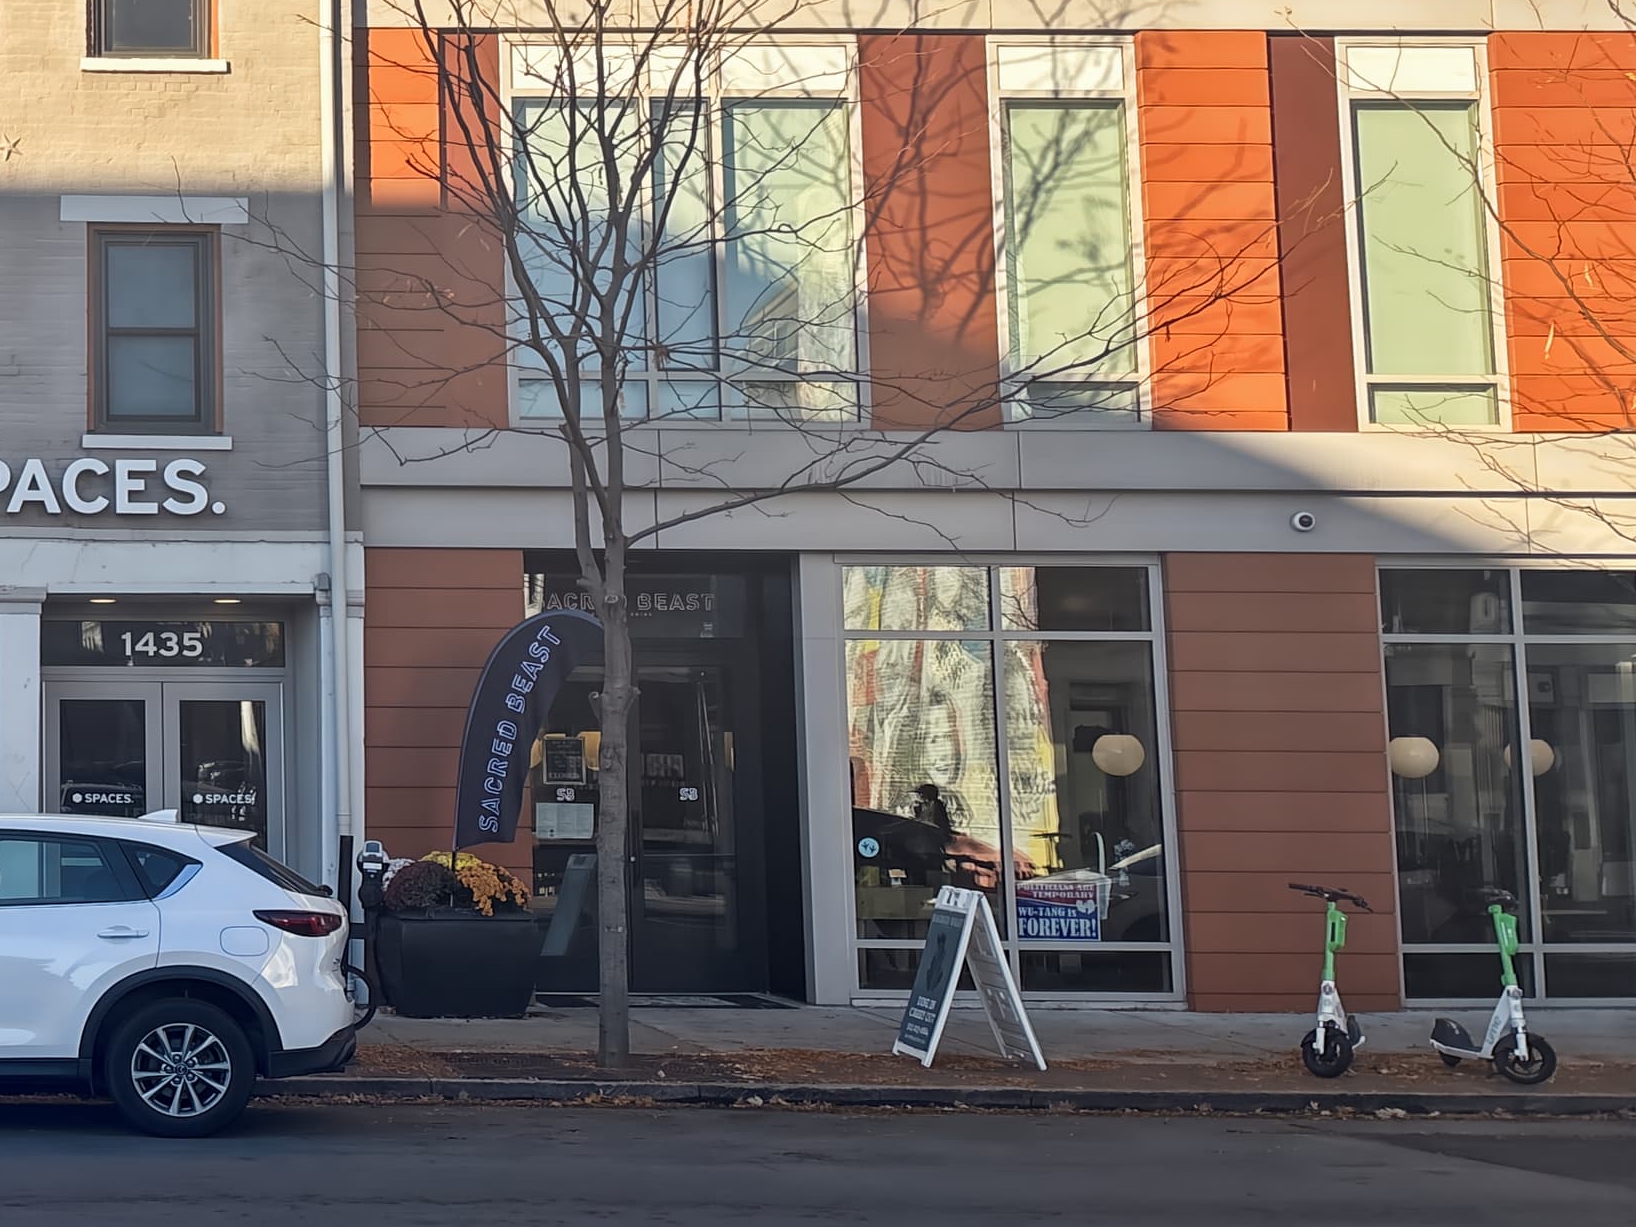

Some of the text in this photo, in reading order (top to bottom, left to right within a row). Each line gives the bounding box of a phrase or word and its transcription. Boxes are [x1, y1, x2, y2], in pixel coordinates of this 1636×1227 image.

[637, 593, 715, 611] BEAST
[121, 632, 203, 657] 1435
[479, 625, 561, 833] SACRED BEAST
[85, 793, 134, 804] SPACES.
[1018, 906, 1065, 917] WU-TANG
[1018, 917, 1096, 938] FOREVER!
